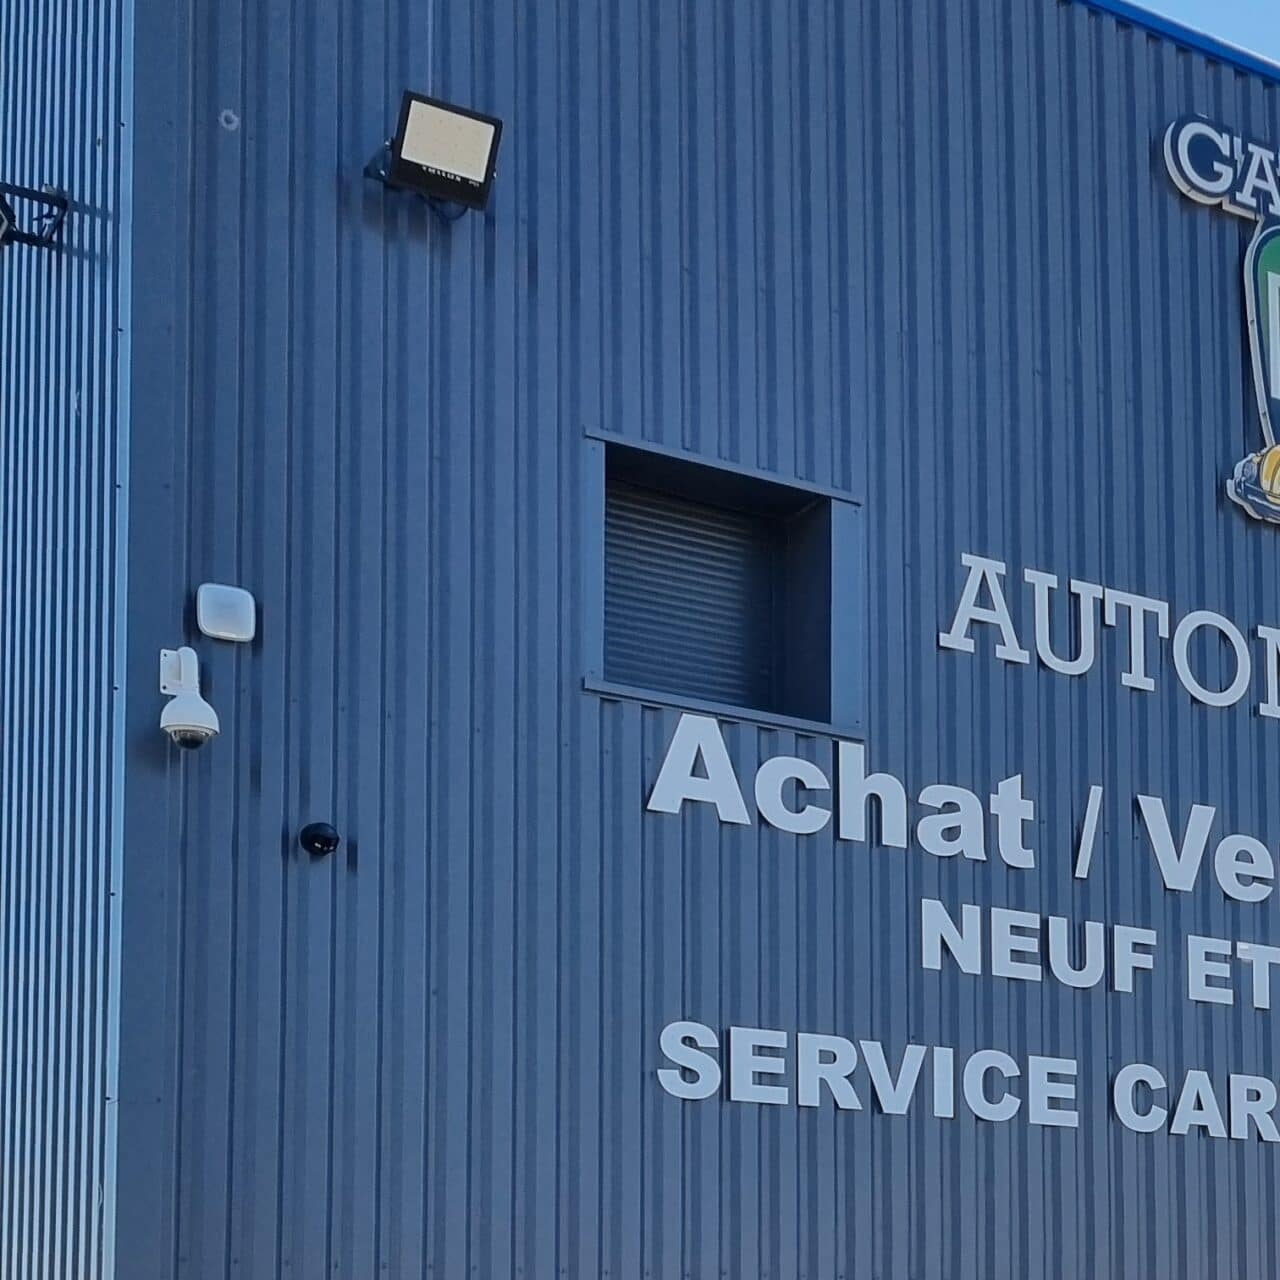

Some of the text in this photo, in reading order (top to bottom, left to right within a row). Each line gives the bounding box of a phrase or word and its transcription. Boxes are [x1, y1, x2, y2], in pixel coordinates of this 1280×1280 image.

[647, 712, 1035, 869] Achat
[1075, 784, 1103, 879] /
[922, 898, 1157, 993] NEUF
[657, 1020, 1080, 1128] SERVICE
